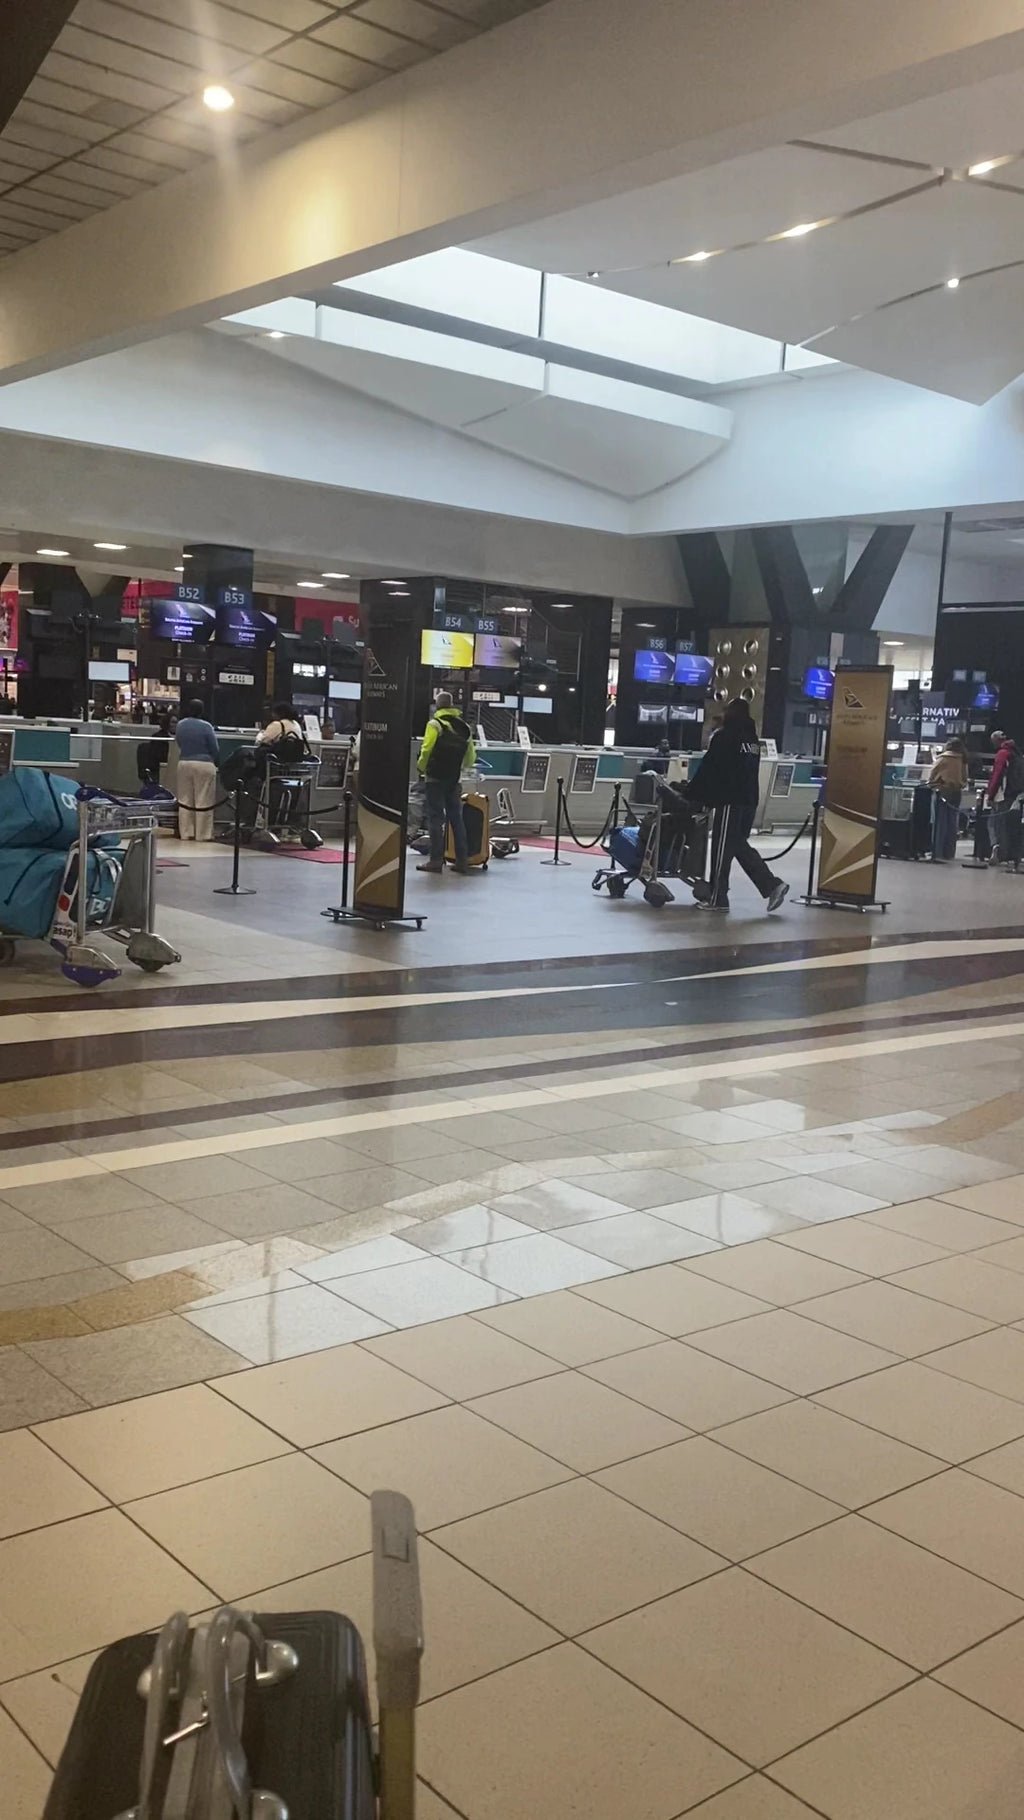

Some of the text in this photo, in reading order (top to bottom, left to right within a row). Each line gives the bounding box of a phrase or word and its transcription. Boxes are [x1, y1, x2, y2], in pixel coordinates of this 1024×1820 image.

[178, 586, 200, 600] B52
[224, 591, 245, 605] B53
[445, 616, 462, 628] B54
[478, 619, 494, 631] B55
[650, 638, 664, 650] B56
